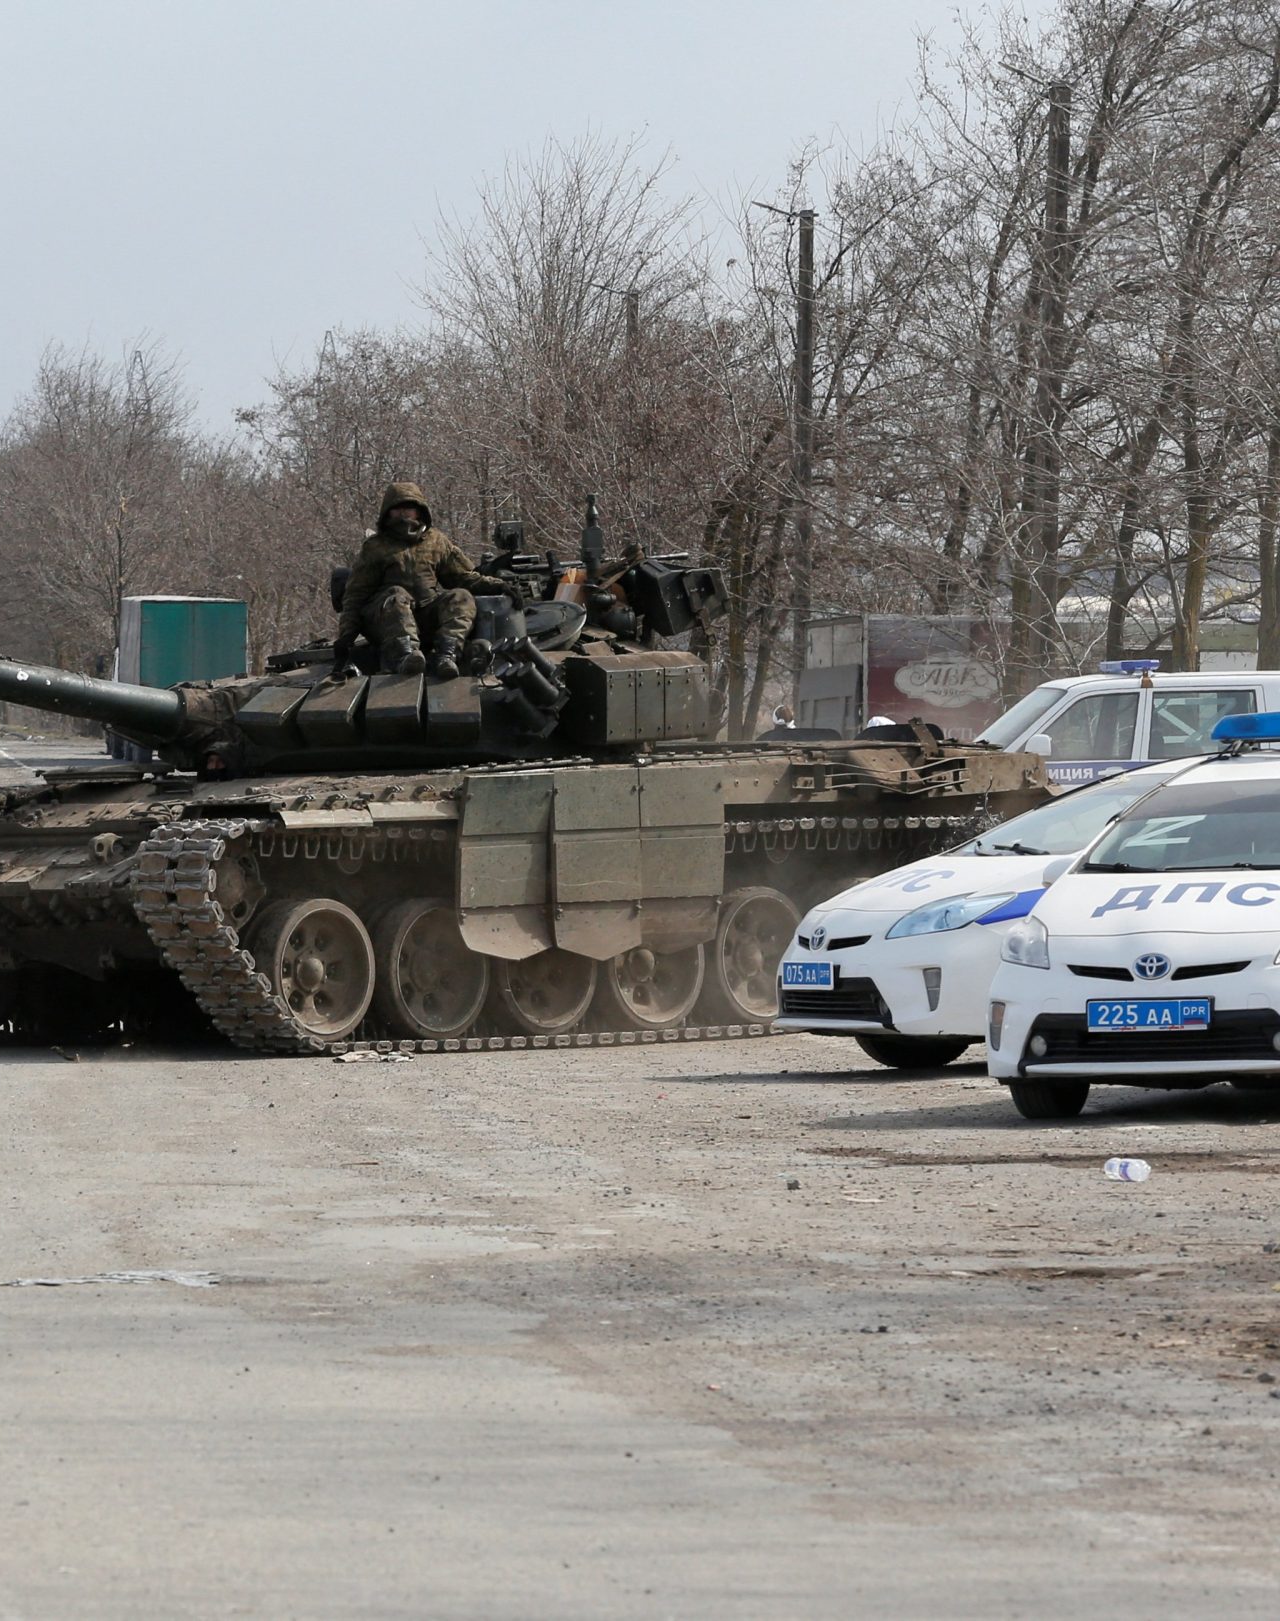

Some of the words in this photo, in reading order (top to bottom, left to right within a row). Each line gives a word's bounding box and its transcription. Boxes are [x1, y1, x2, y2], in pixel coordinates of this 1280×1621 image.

[1090, 882, 1280, 918] ДПС
[786, 965, 803, 982] 075
[805, 969, 817, 982] AA
[1098, 1004, 1138, 1025] 225
[1146, 1008, 1173, 1025] AA
[1183, 1006, 1206, 1015] DPR
